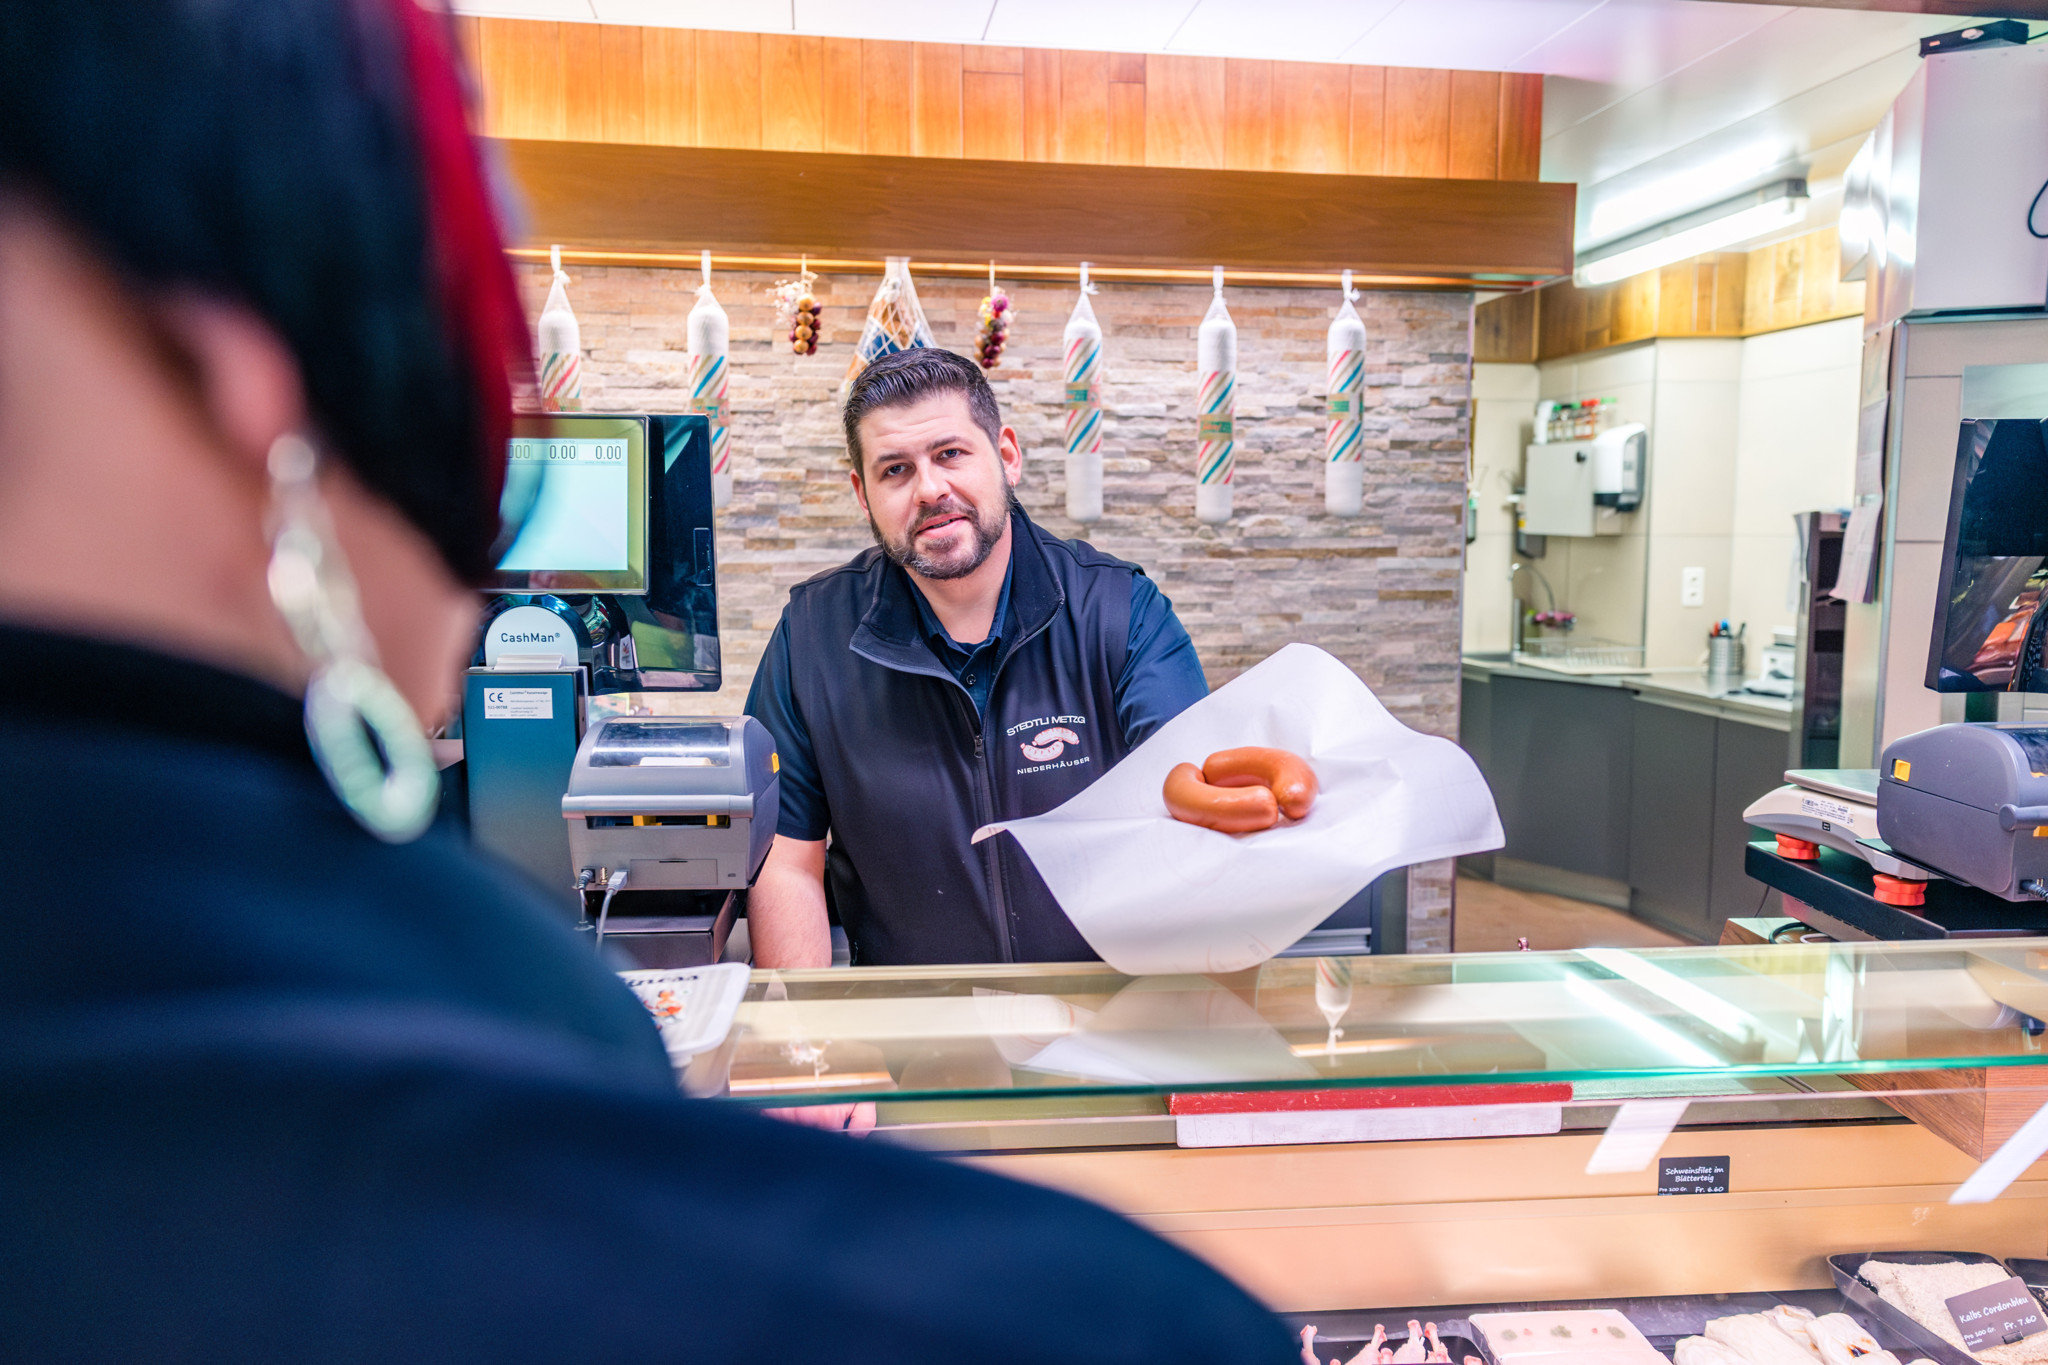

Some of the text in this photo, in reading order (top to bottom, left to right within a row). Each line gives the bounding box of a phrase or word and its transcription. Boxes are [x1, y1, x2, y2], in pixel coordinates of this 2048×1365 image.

[549, 444, 577, 459] 0.00
[595, 445, 622, 460] 0.00
[1006, 715, 1086, 737] STEDTLI METZG
[1017, 756, 1090, 775] NIEDERHÄUSER
[1665, 1166, 1712, 1175] Schweinsfilet
[1675, 1174, 1714, 1183] Blätterteig
[1959, 1297, 2028, 1324] Kalbs Cordonbleu
[1975, 1329, 1986, 1338] 100
[2003, 1321, 2017, 1331] Fr.
[2017, 1315, 2037, 1326] 7.60
